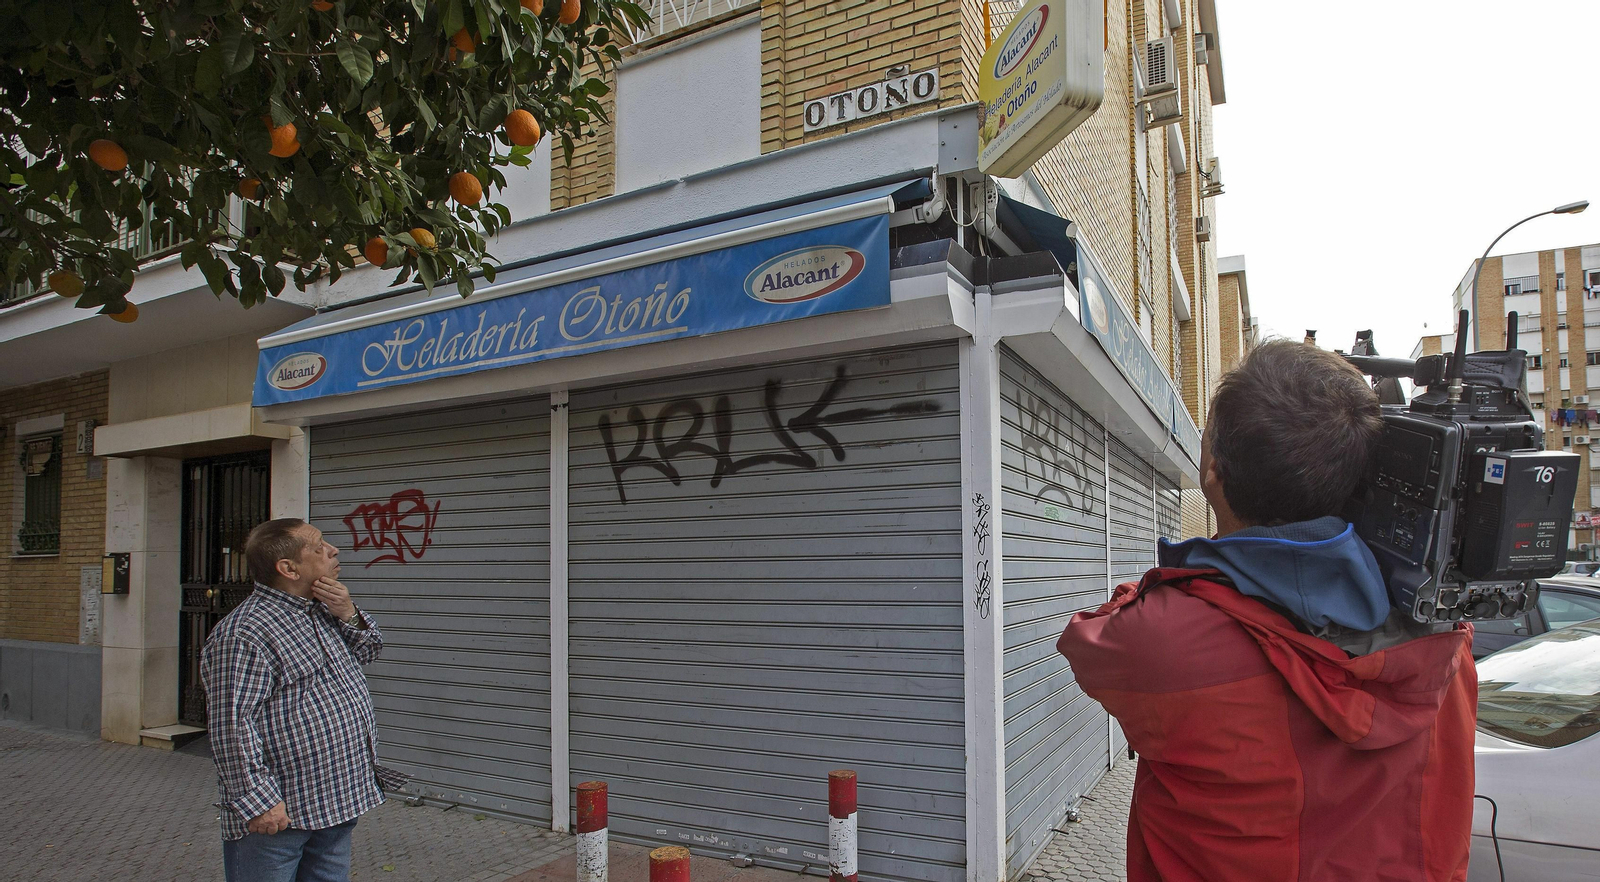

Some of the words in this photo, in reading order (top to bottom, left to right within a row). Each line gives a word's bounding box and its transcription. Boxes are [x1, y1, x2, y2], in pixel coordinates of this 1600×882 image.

[1000, 20, 1037, 72] Alacant
[985, 76, 1022, 117] Heladería
[1026, 34, 1058, 80] Alacant
[804, 64, 936, 127] OTOÑO
[1007, 80, 1037, 118] Otoño
[759, 261, 840, 293] Alacant
[784, 255, 826, 269] HELADOS
[361, 307, 545, 378] Heladería
[558, 281, 692, 342] Otoño
[276, 363, 315, 382] Alacant
[1534, 465, 1555, 483] 76
